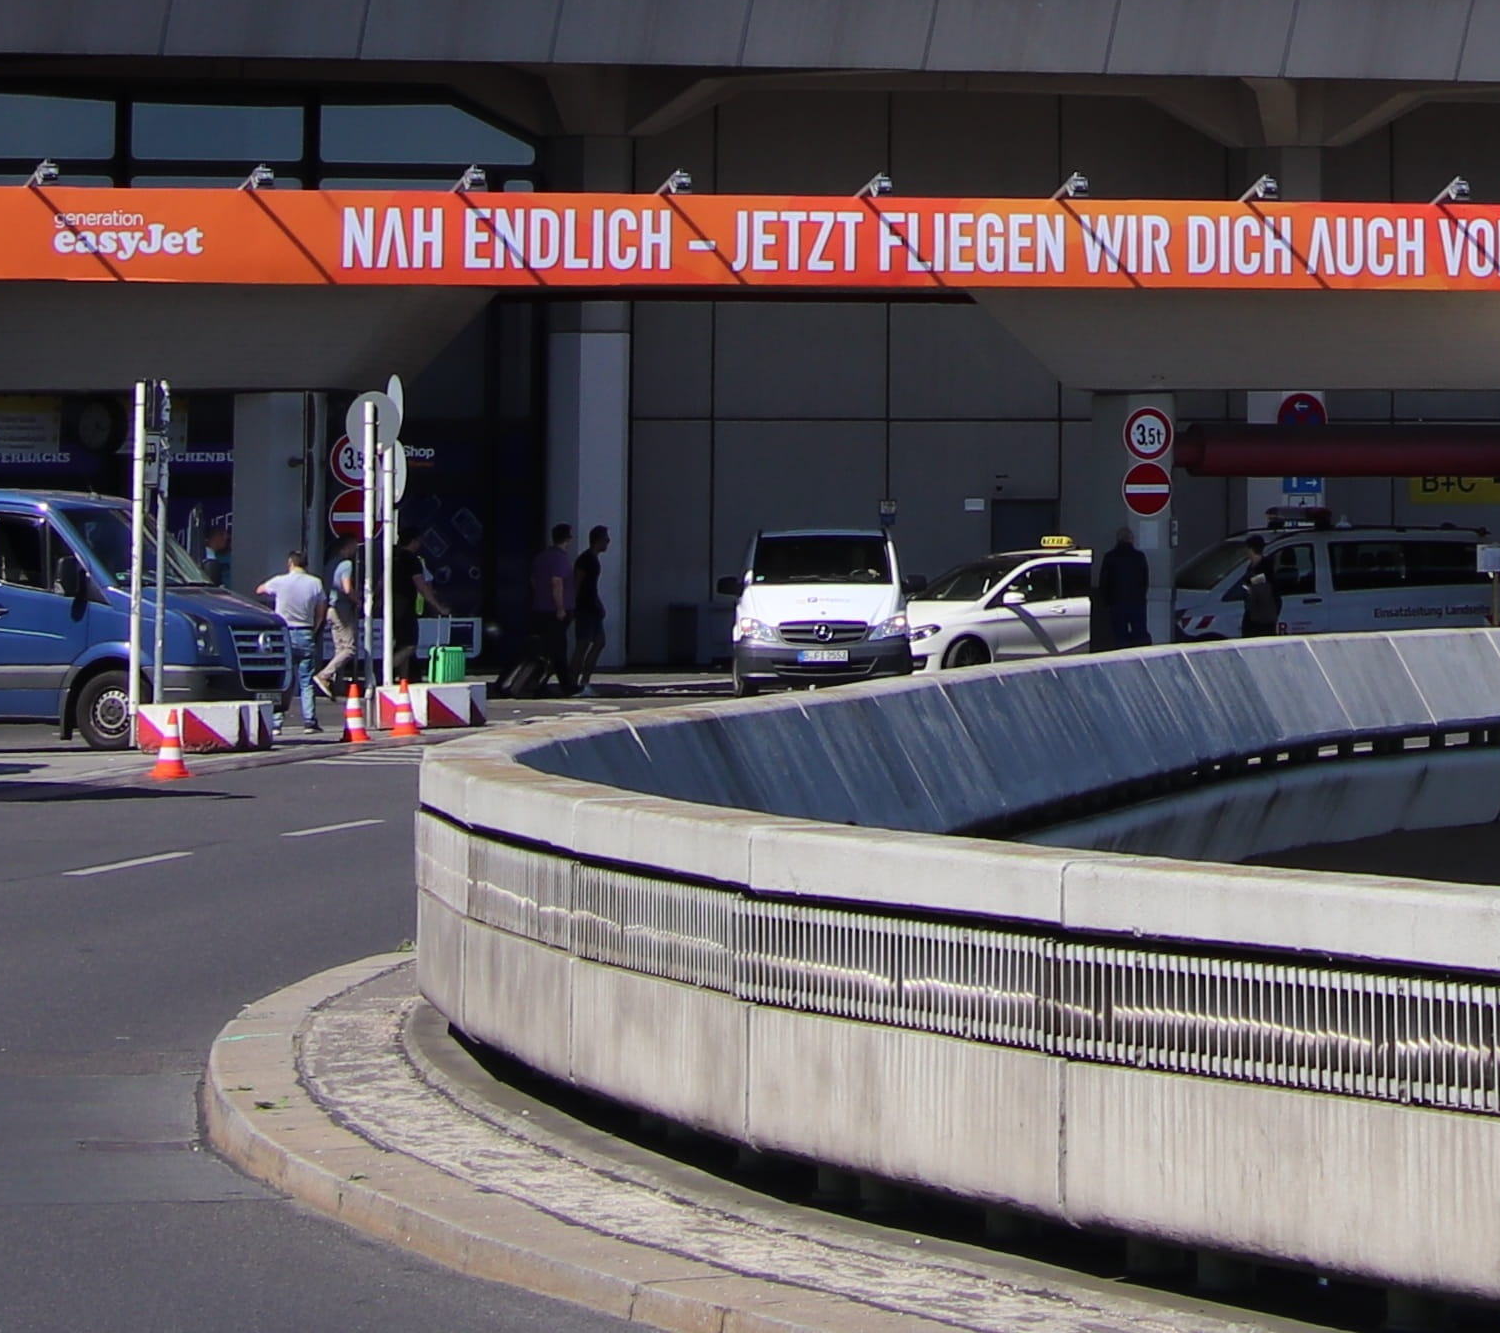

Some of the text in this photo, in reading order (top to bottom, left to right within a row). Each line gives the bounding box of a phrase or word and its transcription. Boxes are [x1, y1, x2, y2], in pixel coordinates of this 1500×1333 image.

[53, 209, 144, 229] generation
[53, 223, 204, 260] easyJet
[342, 206, 444, 270] NAH
[463, 206, 673, 271] ENDLICH
[731, 210, 864, 273] JETZT
[879, 211, 1067, 274] FLIEGEN
[1080, 213, 1173, 275] WIR
[1187, 214, 1292, 276] DICH
[1306, 216, 1425, 277] AUCH
[1373, 607, 1443, 620] Einsatzleitung
